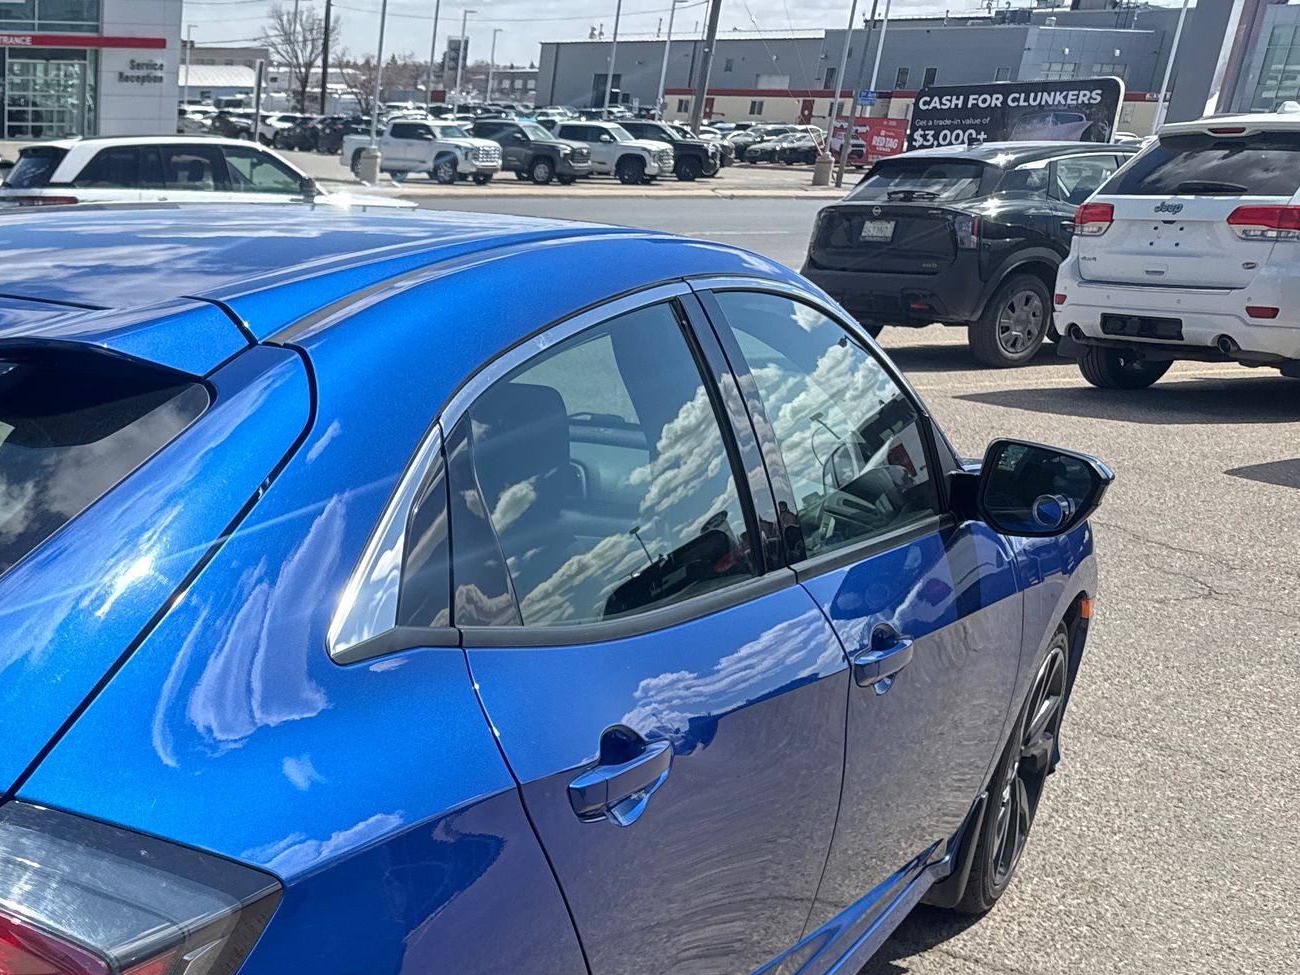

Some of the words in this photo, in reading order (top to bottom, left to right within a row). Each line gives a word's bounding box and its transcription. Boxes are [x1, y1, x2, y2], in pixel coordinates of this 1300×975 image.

[129, 59, 164, 71] Service
[117, 71, 164, 86] Reception
[918, 94, 963, 110] CASH
[967, 93, 1004, 109] FOR
[1007, 89, 1102, 107] CLUNKERS
[915, 118, 927, 127] Get
[933, 117, 961, 126] trade-in
[961, 117, 981, 126] value
[981, 116, 991, 125] of
[872, 135, 886, 148] RED
[885, 138, 899, 149] TAG
[912, 128, 988, 148] $3,000+
[1153, 201, 1184, 216] Jeep
